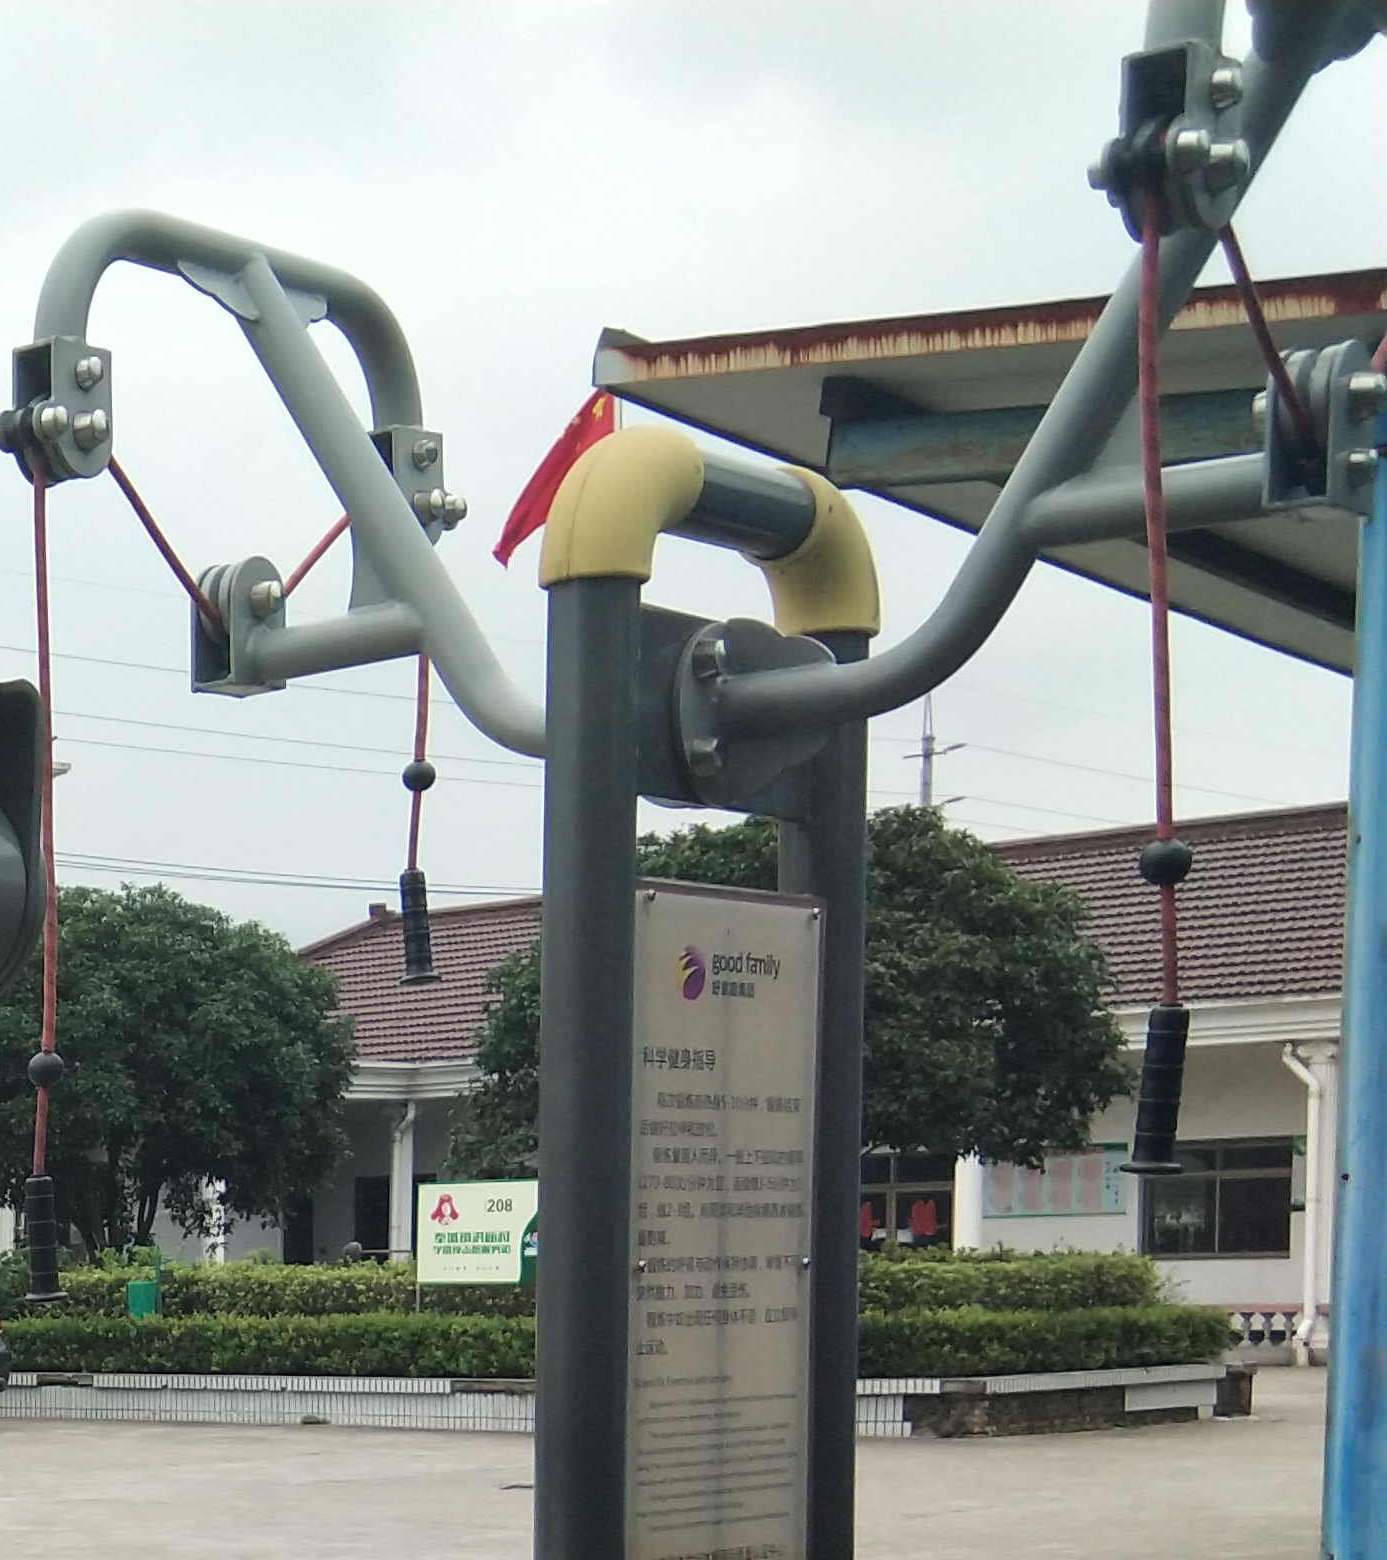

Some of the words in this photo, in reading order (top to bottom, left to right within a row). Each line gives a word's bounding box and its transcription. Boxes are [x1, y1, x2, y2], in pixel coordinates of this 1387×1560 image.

[712, 953, 744, 976] good
[746, 952, 780, 979] family
[642, 1046, 717, 1071] 科学健身指导
[487, 1199, 513, 1213] 208
